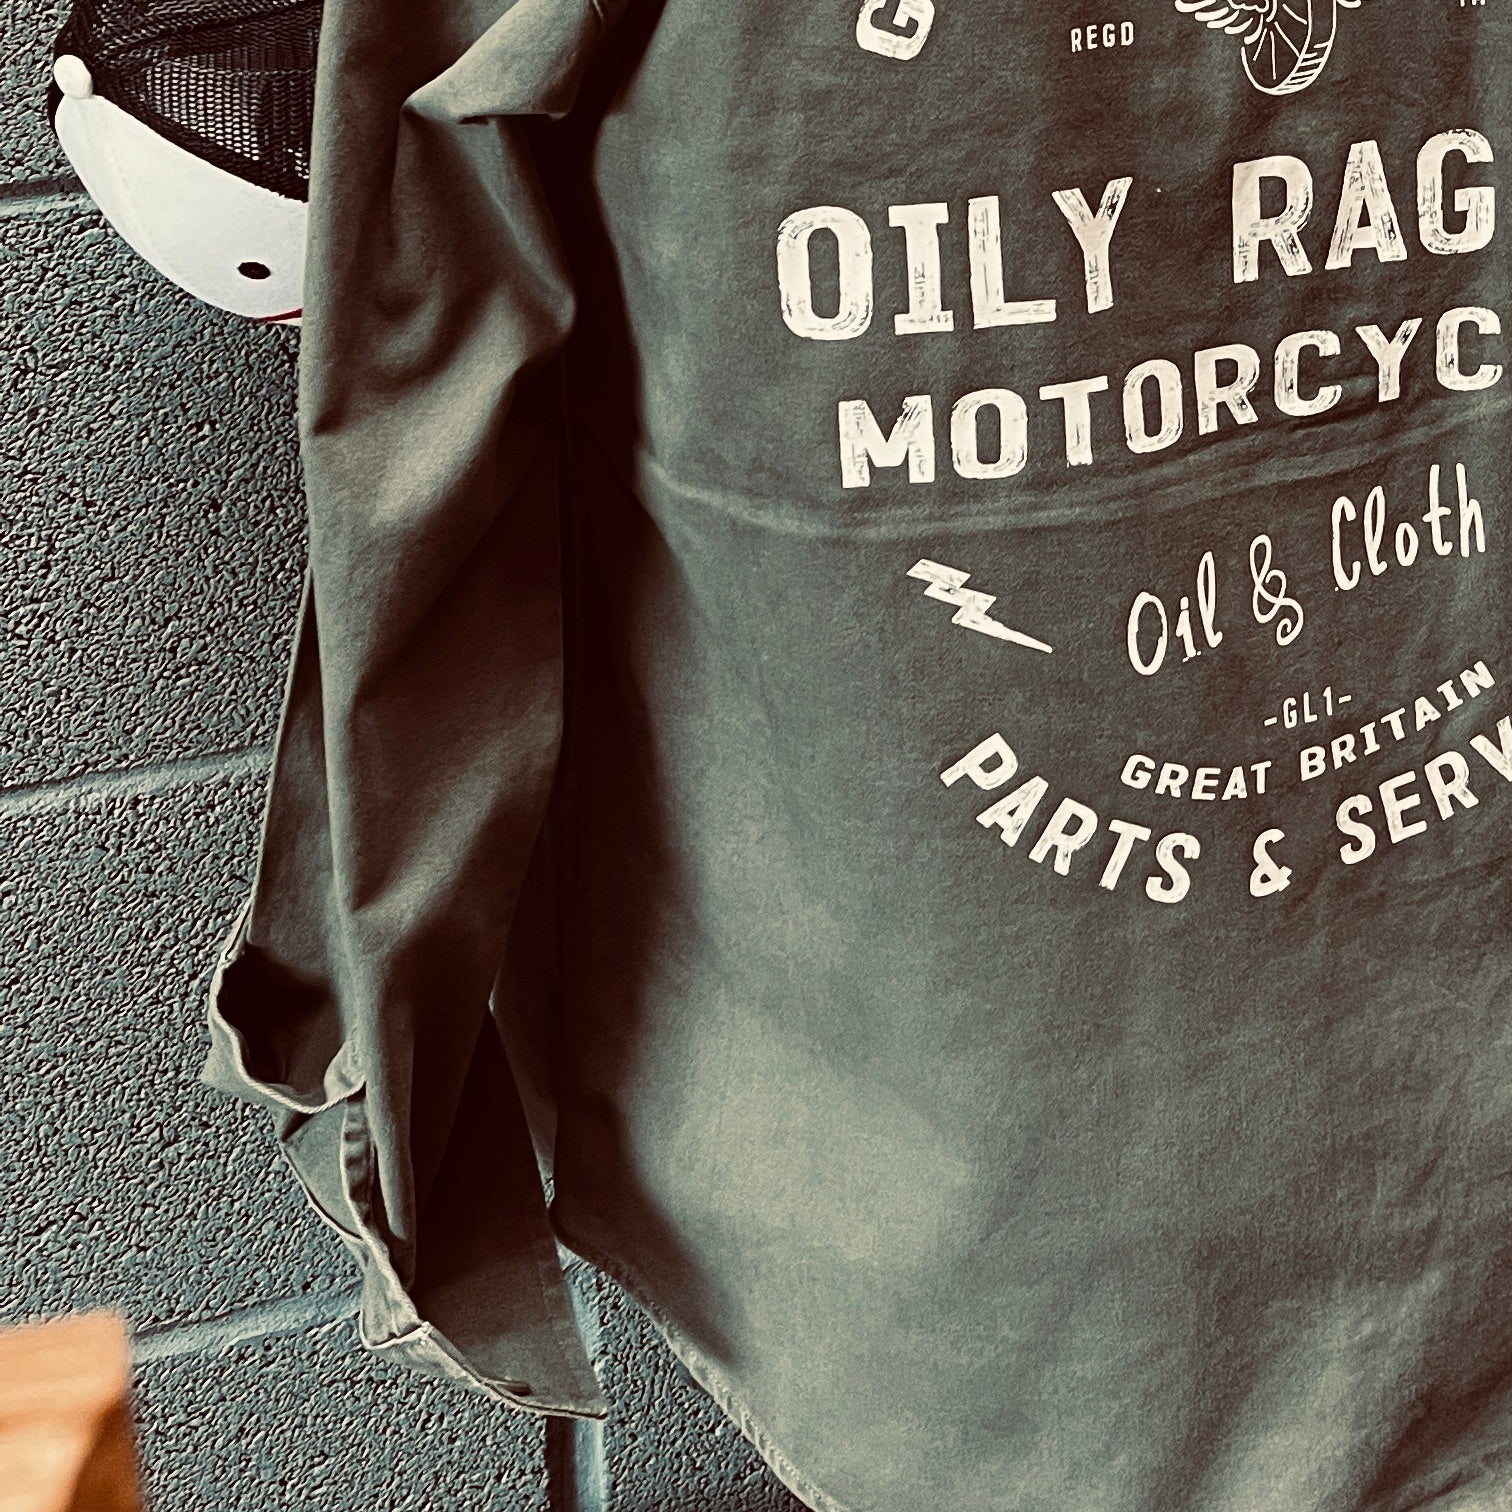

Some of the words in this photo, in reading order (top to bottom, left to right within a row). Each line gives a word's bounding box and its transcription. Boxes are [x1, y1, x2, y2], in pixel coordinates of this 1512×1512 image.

[1070, 21, 1134, 53] REGD
[776, 176, 1133, 341] OILY
[1231, 128, 1496, 284] RAG
[1127, 551, 1223, 676] Oil
[1249, 534, 1304, 646] &
[1331, 462, 1486, 592] Cloth
[1120, 754, 1272, 801] GREAT
[1299, 660, 1497, 782] BRITAIN
[939, 732, 1204, 904] PARTS
[1249, 828, 1293, 898] &
